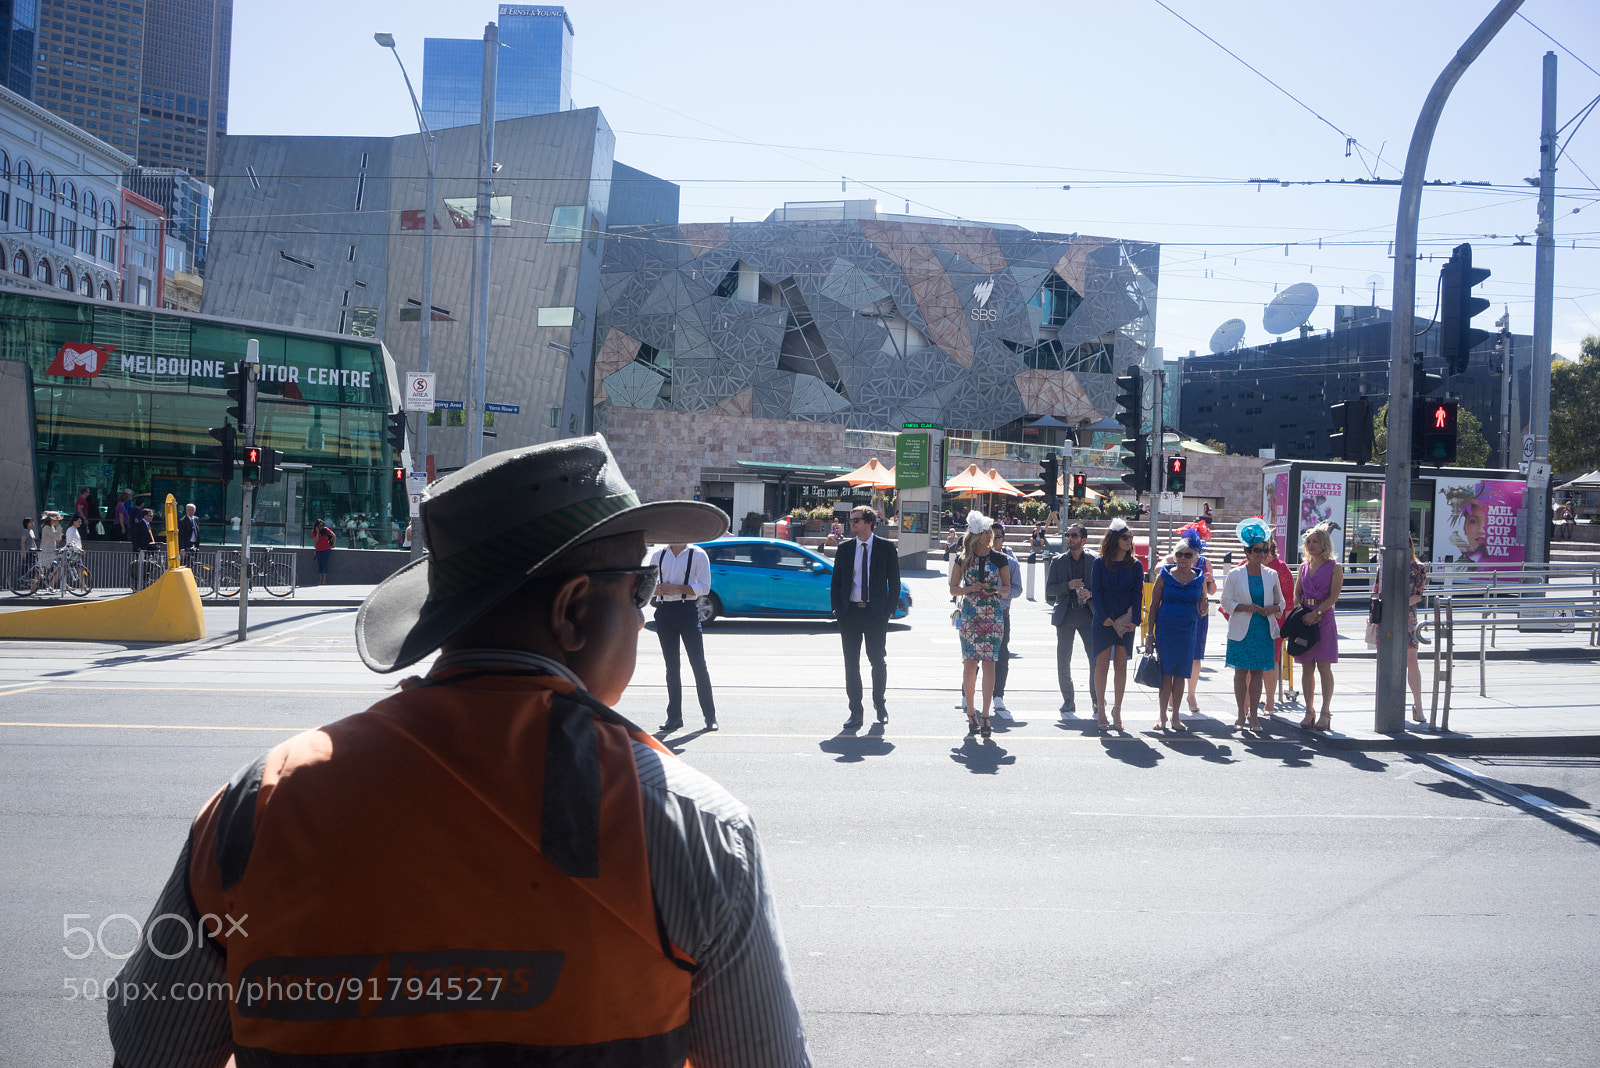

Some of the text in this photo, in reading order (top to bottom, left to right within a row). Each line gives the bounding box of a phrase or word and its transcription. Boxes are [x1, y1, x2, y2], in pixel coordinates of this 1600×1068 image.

[970, 308, 996, 321] SBS
[120, 354, 224, 378] MELBOURNE
[307, 367, 371, 388] CENTRE
[1488, 506, 1513, 515] MEL
[1487, 526, 1510, 536] CUP
[1486, 546, 1509, 556] VAL
[402, 963, 532, 996] trams
